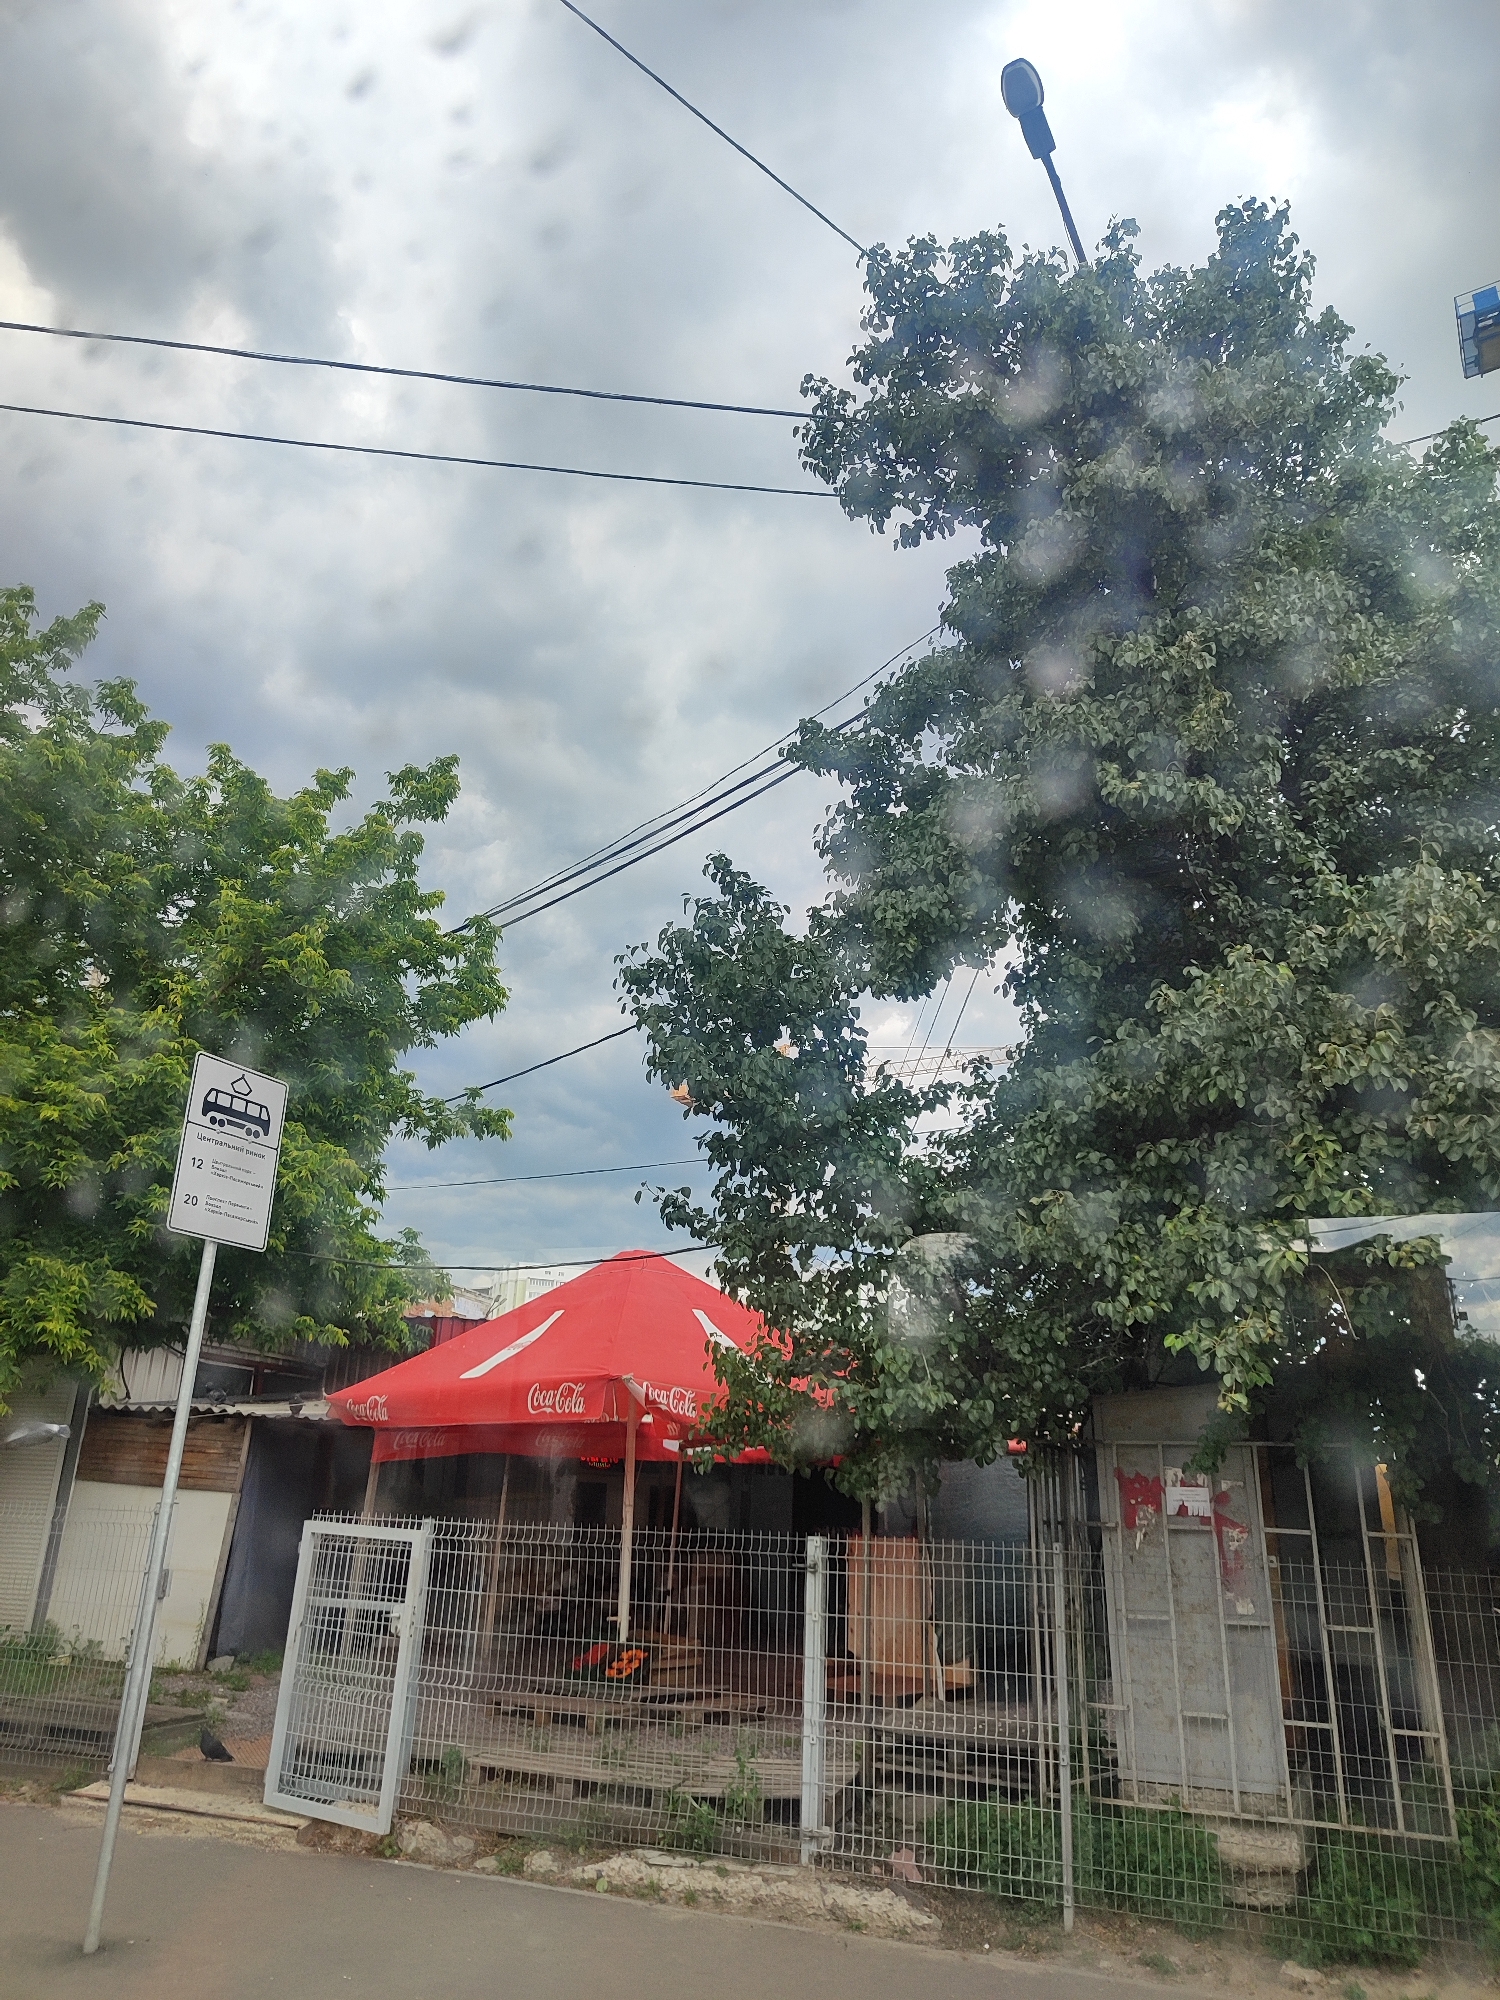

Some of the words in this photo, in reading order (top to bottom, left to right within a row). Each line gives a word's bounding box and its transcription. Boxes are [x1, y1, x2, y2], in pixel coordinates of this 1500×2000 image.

[196, 1132, 245, 1153] Центральний
[245, 1148, 266, 1160] ринок
[191, 1156, 204, 1170] 12
[183, 1193, 199, 1207] 20
